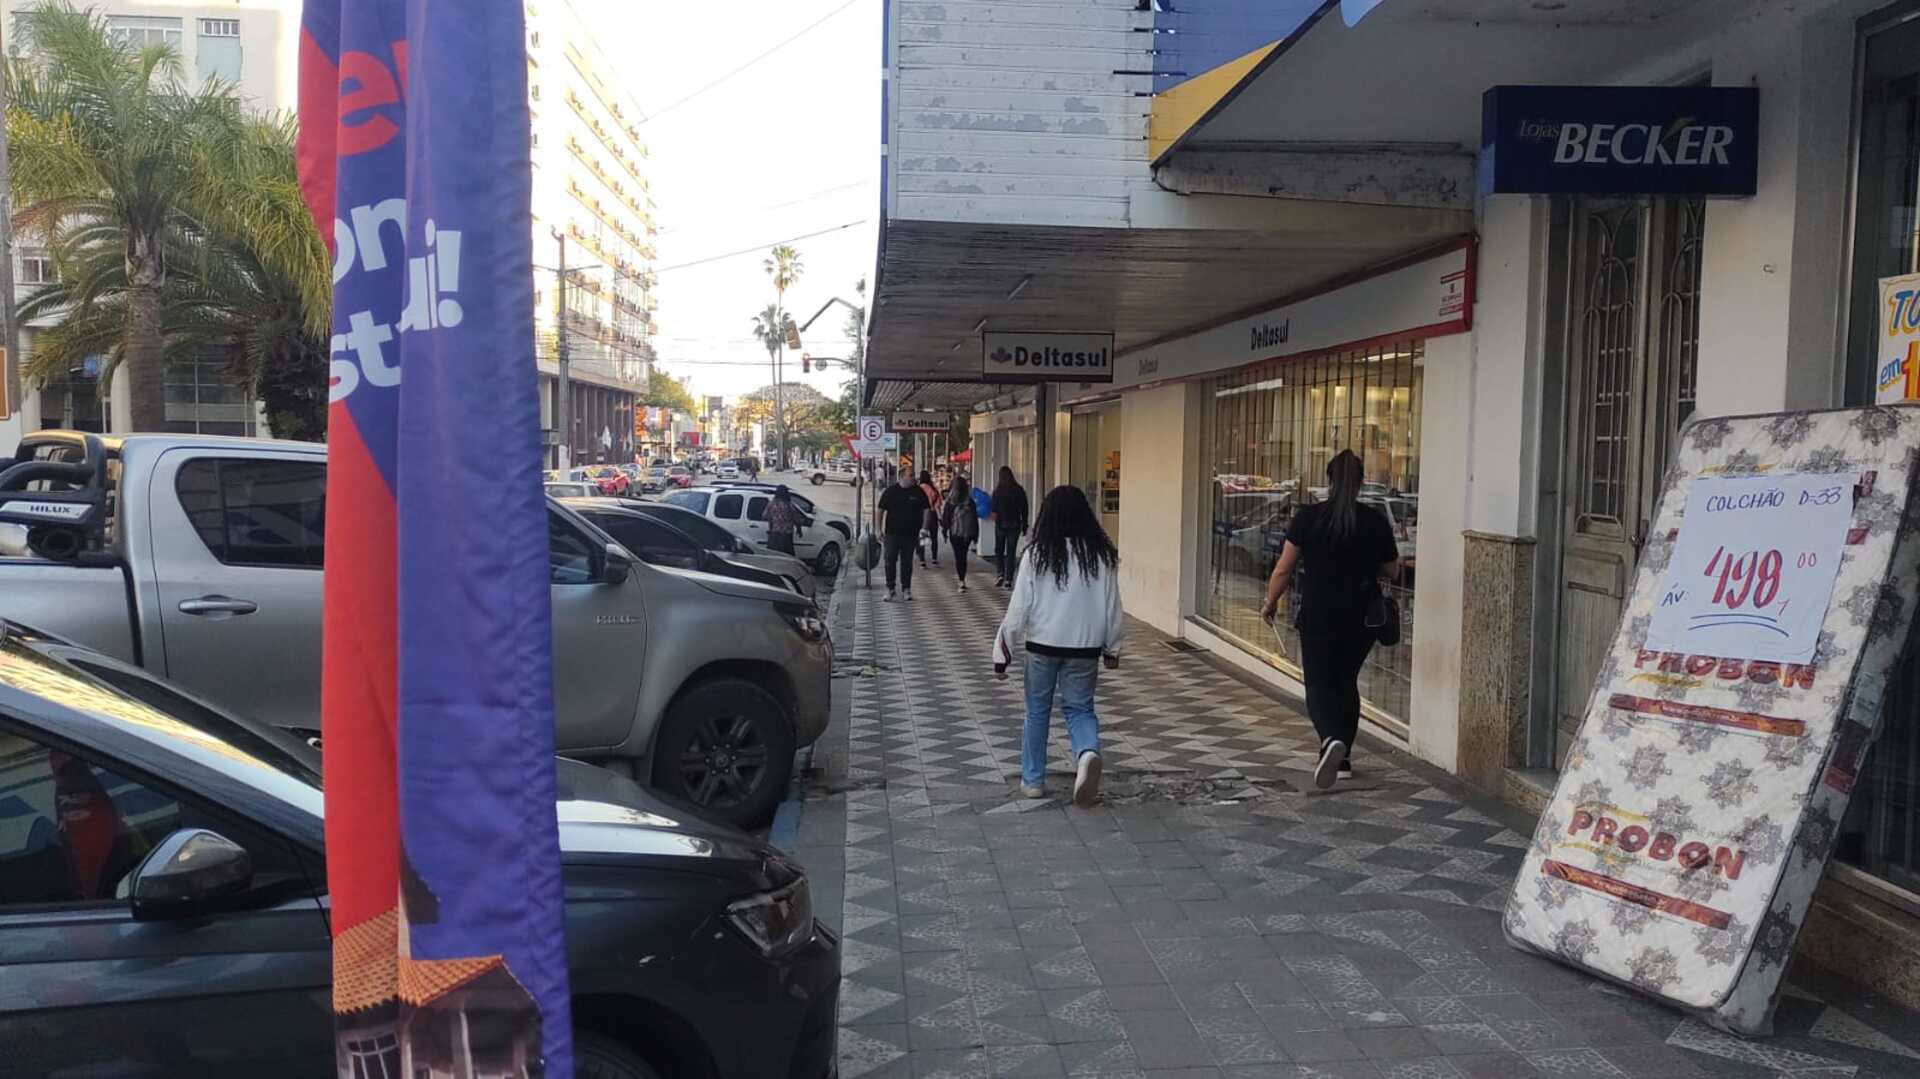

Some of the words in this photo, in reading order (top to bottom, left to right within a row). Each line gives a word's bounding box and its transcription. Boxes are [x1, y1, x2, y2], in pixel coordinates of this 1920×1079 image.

[1553, 122, 1734, 166] BECKER
[1250, 316, 1289, 351] Deltasul
[1014, 346, 1108, 367] Deltasul
[1879, 357, 1901, 386] em
[868, 425, 877, 438] E
[29, 505, 71, 514] HILUX
[1706, 487, 1785, 513] COLCHÃO
[1634, 649, 1818, 690] PROBON
[1567, 809, 1744, 881] PROBON
